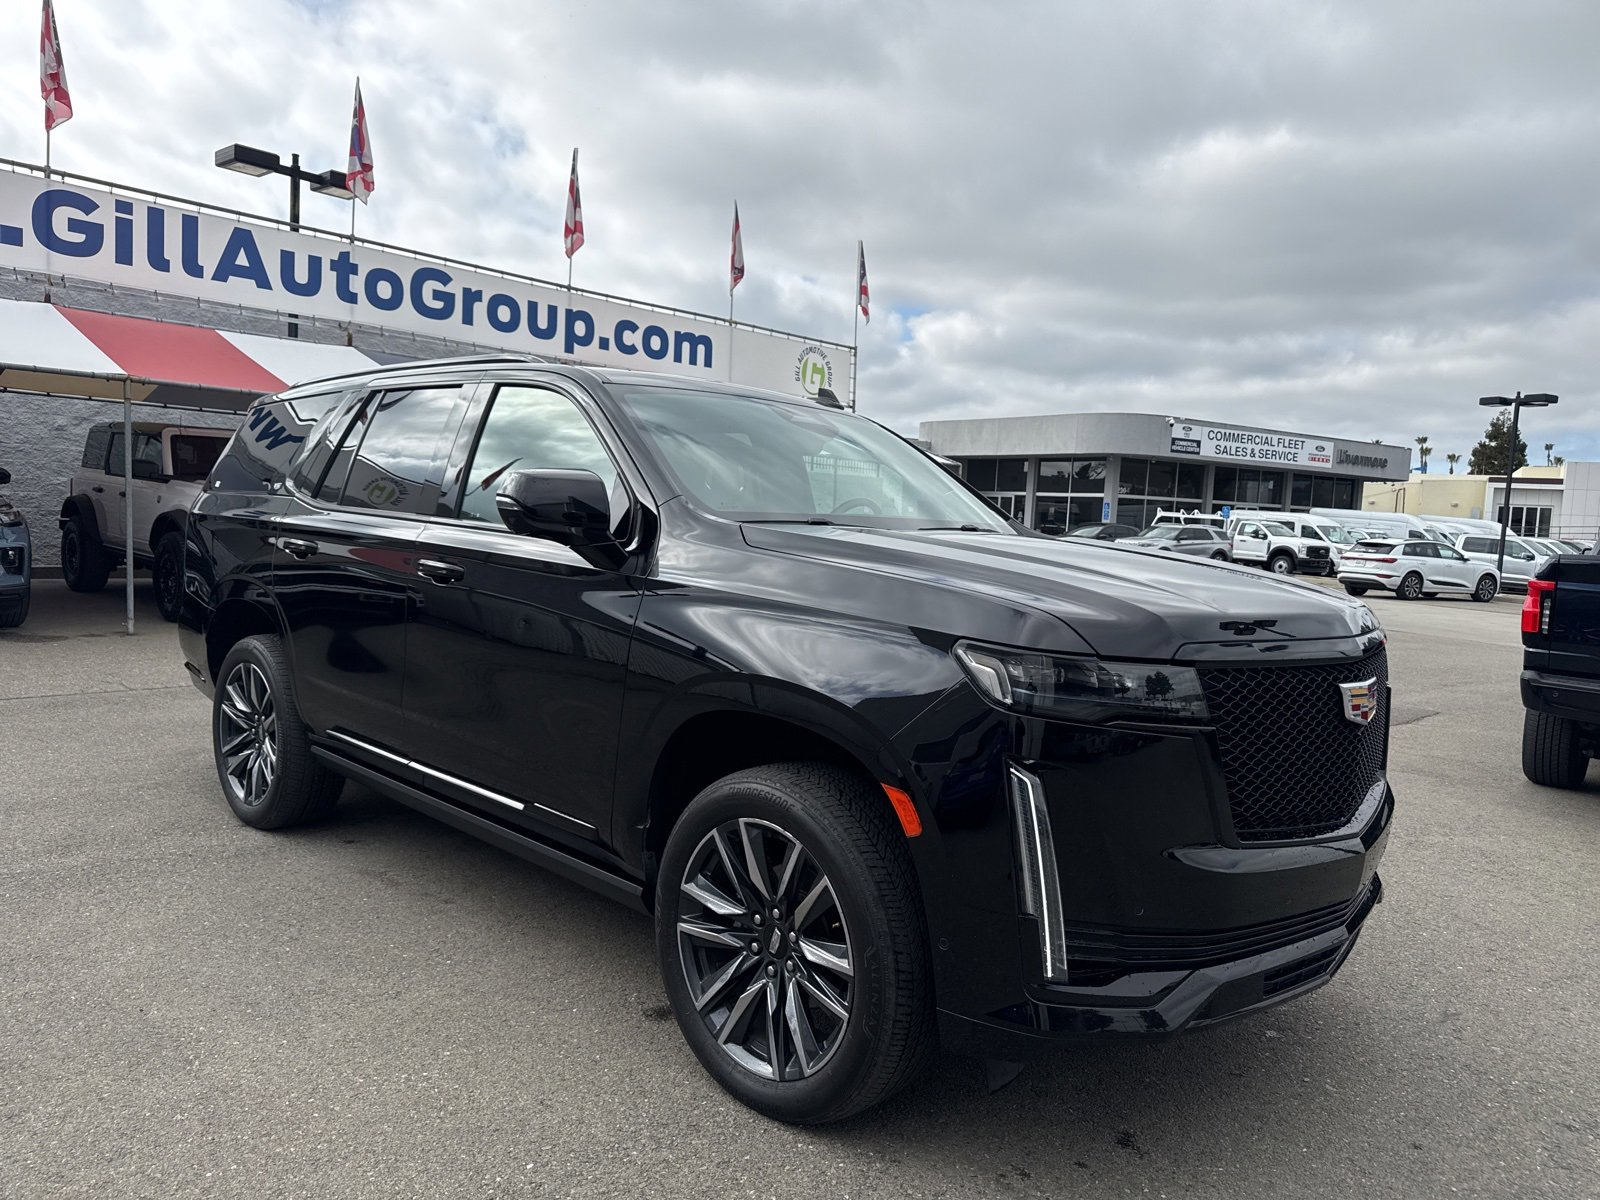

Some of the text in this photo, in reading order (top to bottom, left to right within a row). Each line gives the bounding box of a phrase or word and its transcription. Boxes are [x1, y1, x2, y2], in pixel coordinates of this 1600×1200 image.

[798, 346, 827, 365] AUTOMOTIVE
[825, 361, 833, 388] GROUP
[1207, 429, 1278, 447] COMMERCIAL
[1277, 437, 1306, 450] FLEET
[1214, 444, 1248, 457] SALES
[1249, 448, 1256, 458] &
[1258, 448, 1299, 462] SERVICE
